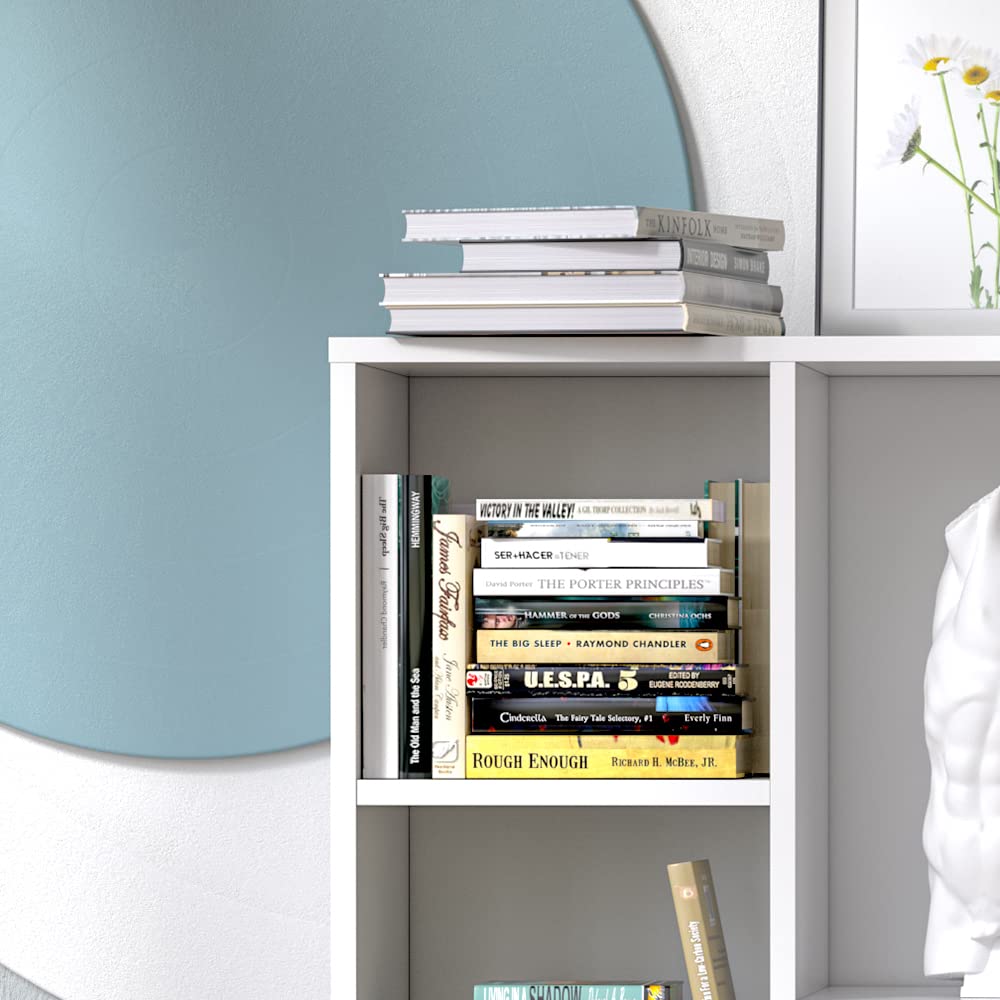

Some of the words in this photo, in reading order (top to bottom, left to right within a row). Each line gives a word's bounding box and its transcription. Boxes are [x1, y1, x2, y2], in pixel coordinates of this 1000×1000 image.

[657, 214, 711, 238] KINFOLK
[710, 251, 727, 271] DESIGN
[480, 503, 512, 519] VICTORY
[512, 503, 522, 518] IN
[525, 503, 540, 518] THE
[542, 503, 575, 519] VALLEY!
[411, 491, 420, 549] HEMMINGWAY
[432, 520, 462, 575] James
[485, 580, 507, 588] David
[509, 580, 533, 588] Porter
[537, 579, 565, 589] THE
[569, 579, 622, 589] PORTER
[432, 578, 461, 641] Fairfax
[524, 611, 567, 620] HAMMER
[592, 611, 620, 620] GODS
[490, 640, 508, 648] THE
[512, 640, 530, 648] BIG
[534, 640, 562, 648] SLEEP
[576, 640, 629, 648] RAYMOND
[633, 640, 687, 648] CHANDLER
[409, 667, 420, 684] Sea
[524, 670, 610, 689] U.E.S.P.A.
[618, 670, 638, 691] 5
[668, 671, 690, 679] EDITED
[691, 671, 700, 679] BY
[409, 685, 420, 698] the
[649, 680, 673, 689] EUGENE
[674, 680, 720, 689] RODDENBERRY
[410, 699, 420, 715] and
[409, 716, 420, 734] Man
[499, 711, 547, 723] Cinderella
[555, 713, 566, 722] The
[571, 713, 589, 724] Fairy
[590, 714, 606, 722] Tale
[607, 714, 642, 724] Selectory,
[644, 714, 653, 722] #1
[684, 713, 710, 724] Everly
[713, 713, 733, 722] Finn
[409, 734, 420, 748] Old
[409, 749, 420, 764] The
[472, 753, 522, 769] ROUGH
[528, 753, 588, 769] ENOUGH
[611, 756, 650, 768] RICHARD
[652, 756, 662, 768] H.
[701, 757, 718, 768] JR.
